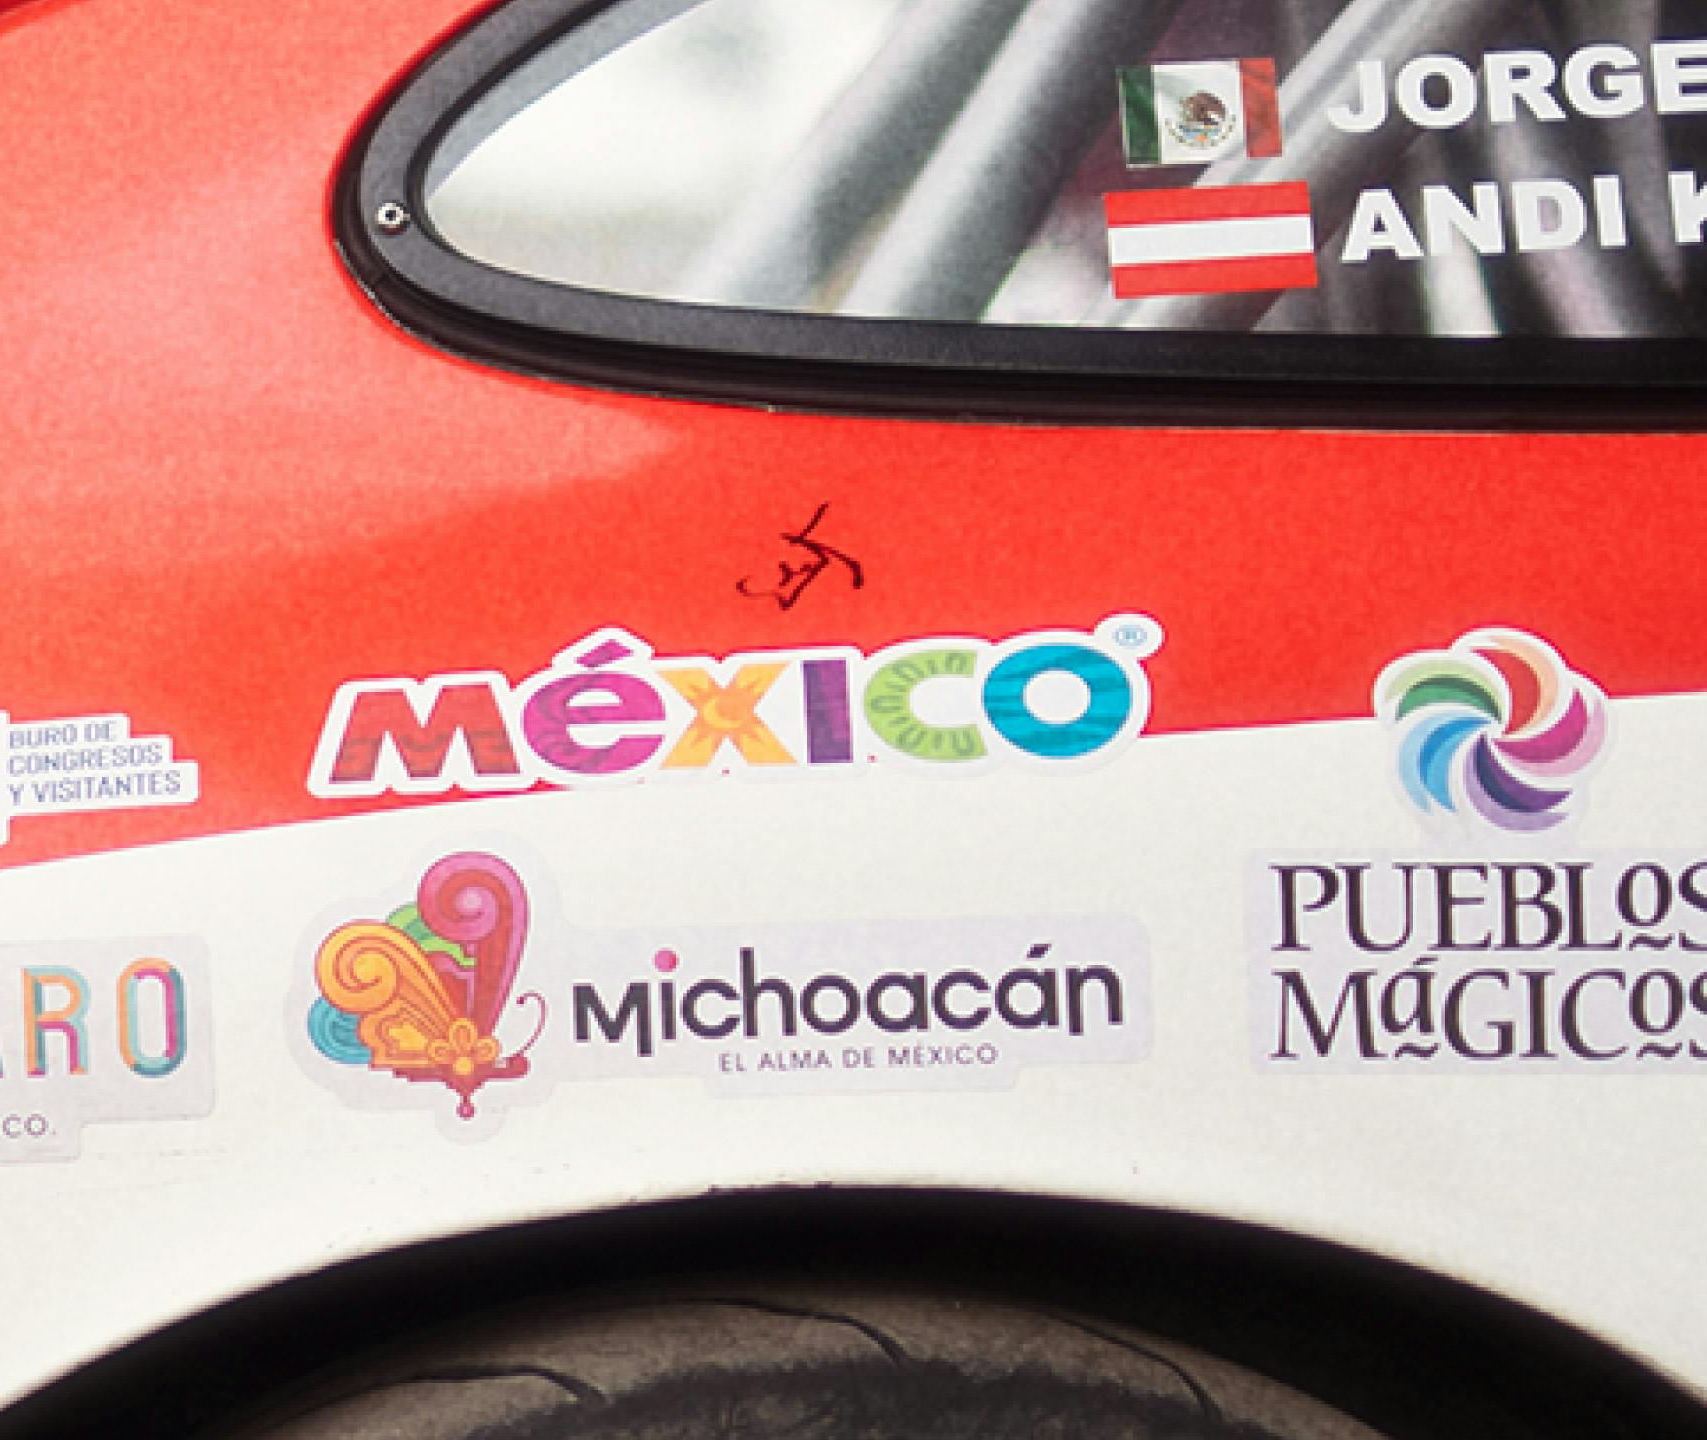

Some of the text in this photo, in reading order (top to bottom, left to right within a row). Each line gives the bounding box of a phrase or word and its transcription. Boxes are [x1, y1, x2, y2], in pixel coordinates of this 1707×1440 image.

[1328, 40, 1707, 133] JORGE
[1342, 174, 1627, 263] ANDI
[84, 720, 117, 742] DE
[7, 744, 163, 776] CONGRESOS
[9, 770, 181, 805] Y VISITANTES
[718, 1053, 745, 1072] EL
[758, 1050, 832, 1071] ALMA
[842, 1047, 875, 1069] DE
